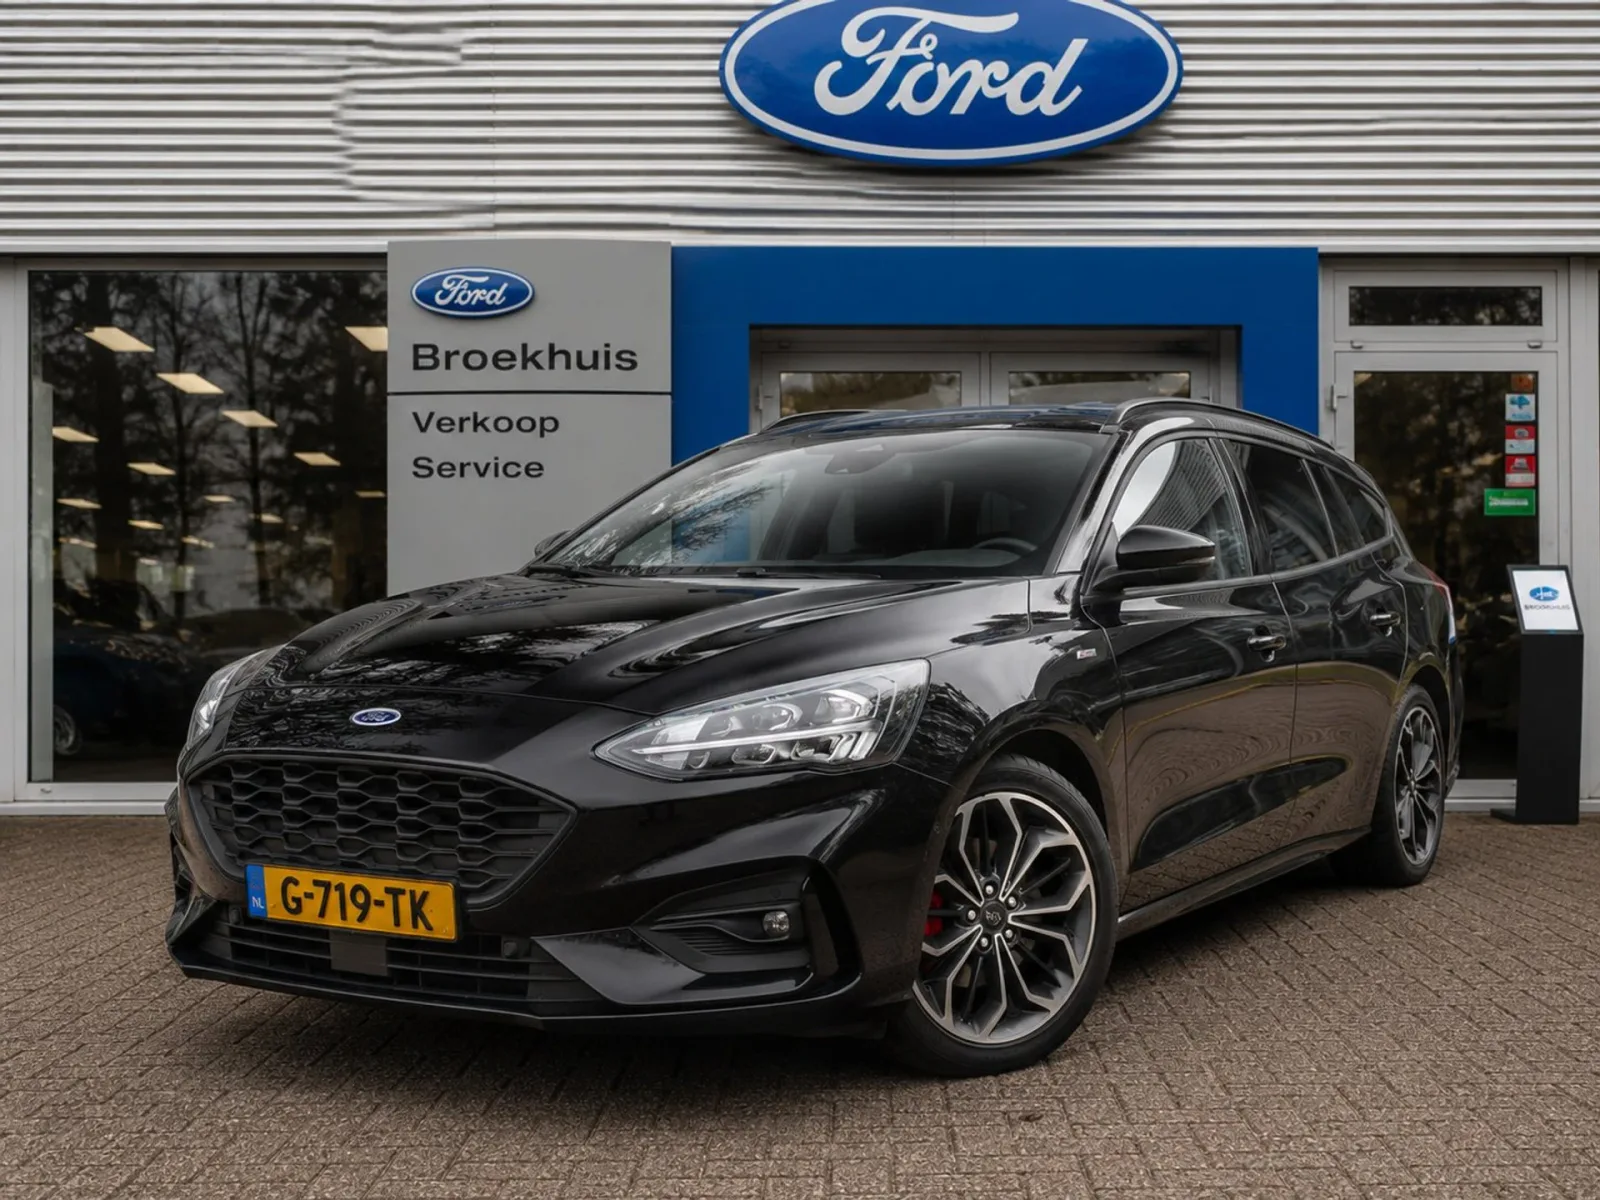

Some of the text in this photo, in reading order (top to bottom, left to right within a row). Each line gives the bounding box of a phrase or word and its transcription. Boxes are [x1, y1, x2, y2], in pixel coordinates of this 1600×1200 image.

[814, 6, 1088, 116] Ford
[434, 274, 508, 305] Ford
[412, 343, 638, 371] Broekhuis
[412, 411, 560, 438] Verkoop
[412, 456, 544, 478] Service
[252, 896, 264, 909] NL
[281, 876, 433, 931] G-719-TK
